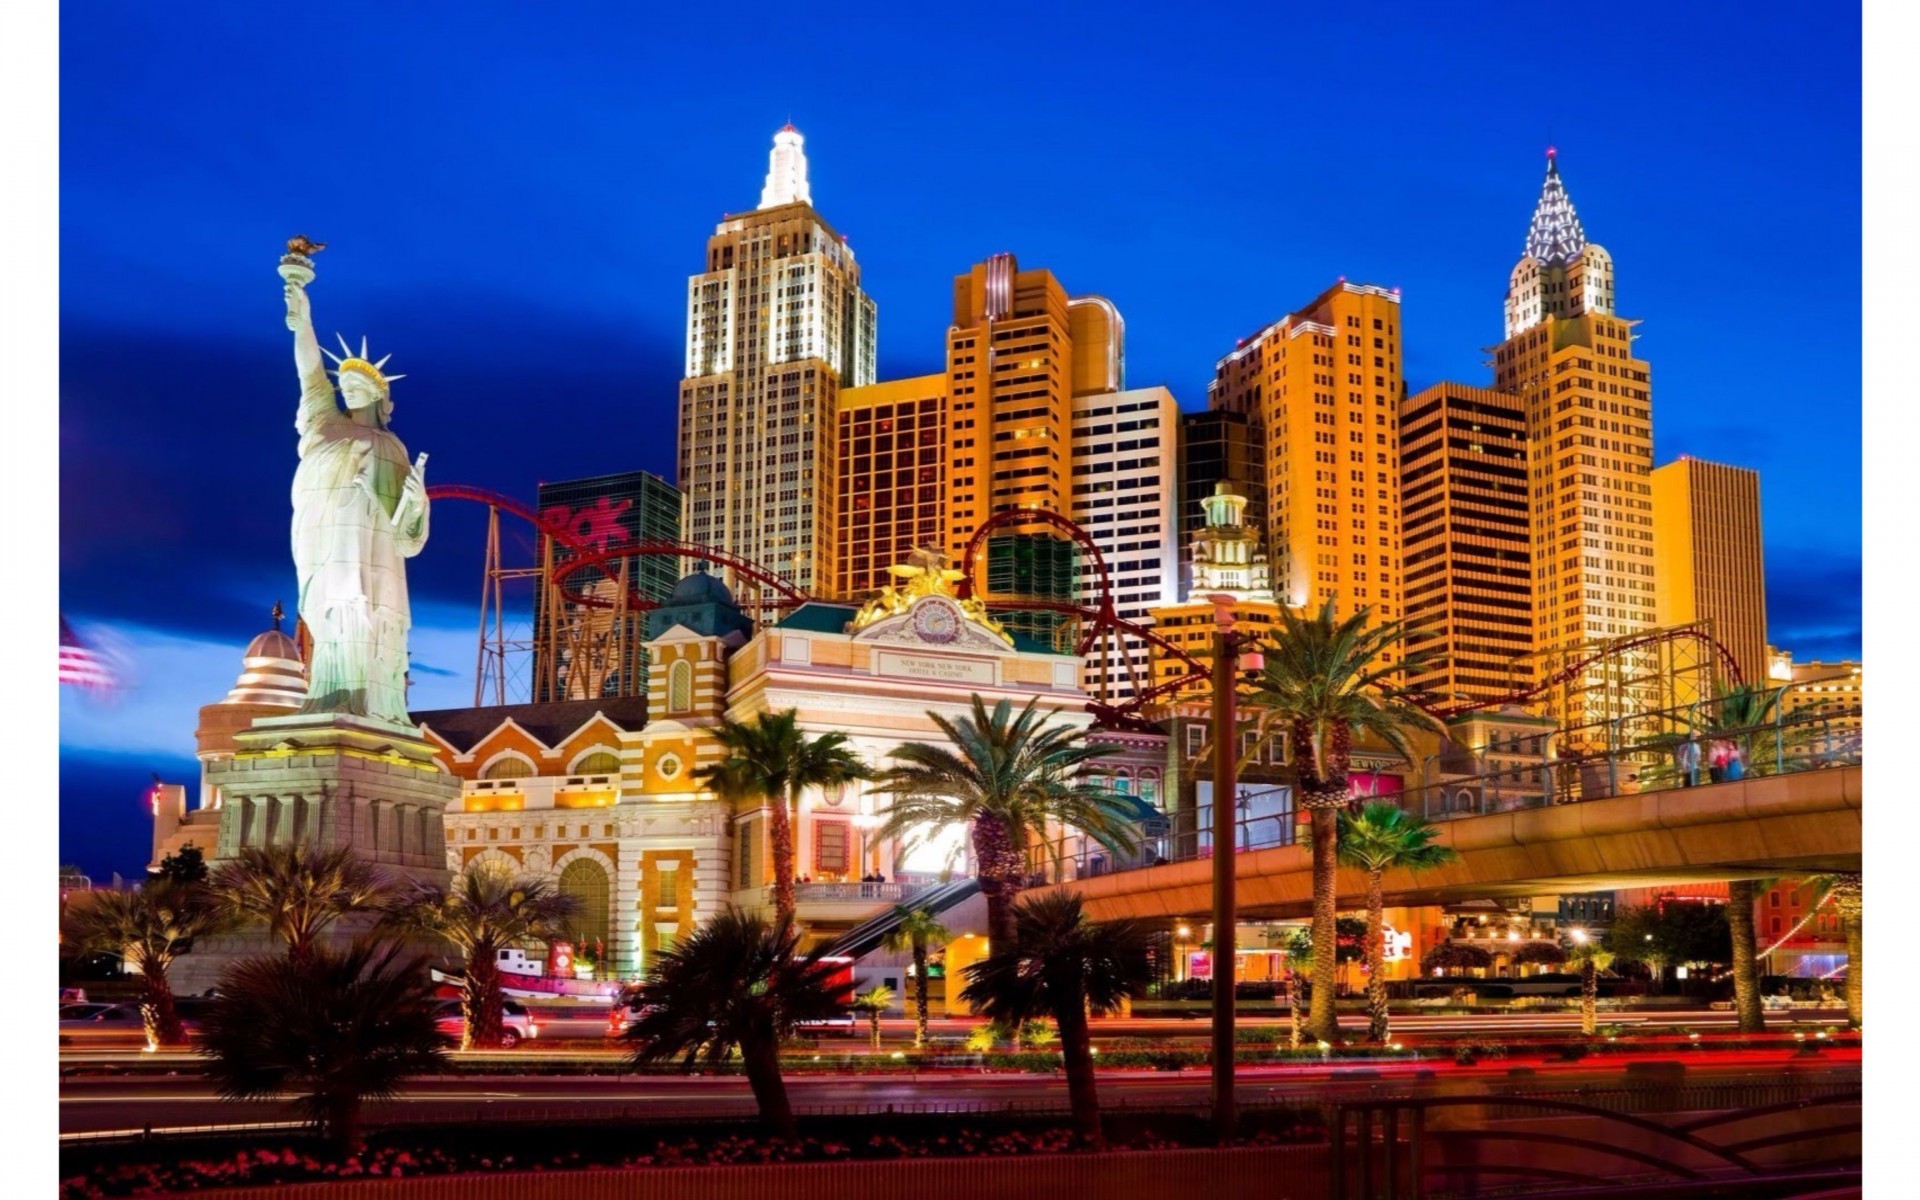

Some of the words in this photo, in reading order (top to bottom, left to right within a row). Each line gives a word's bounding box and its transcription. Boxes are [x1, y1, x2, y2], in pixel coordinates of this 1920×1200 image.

[919, 661, 935, 669] YORK
[955, 664, 972, 672] YORK
[908, 667, 929, 675] HOTEL
[938, 670, 963, 678] CASINO
